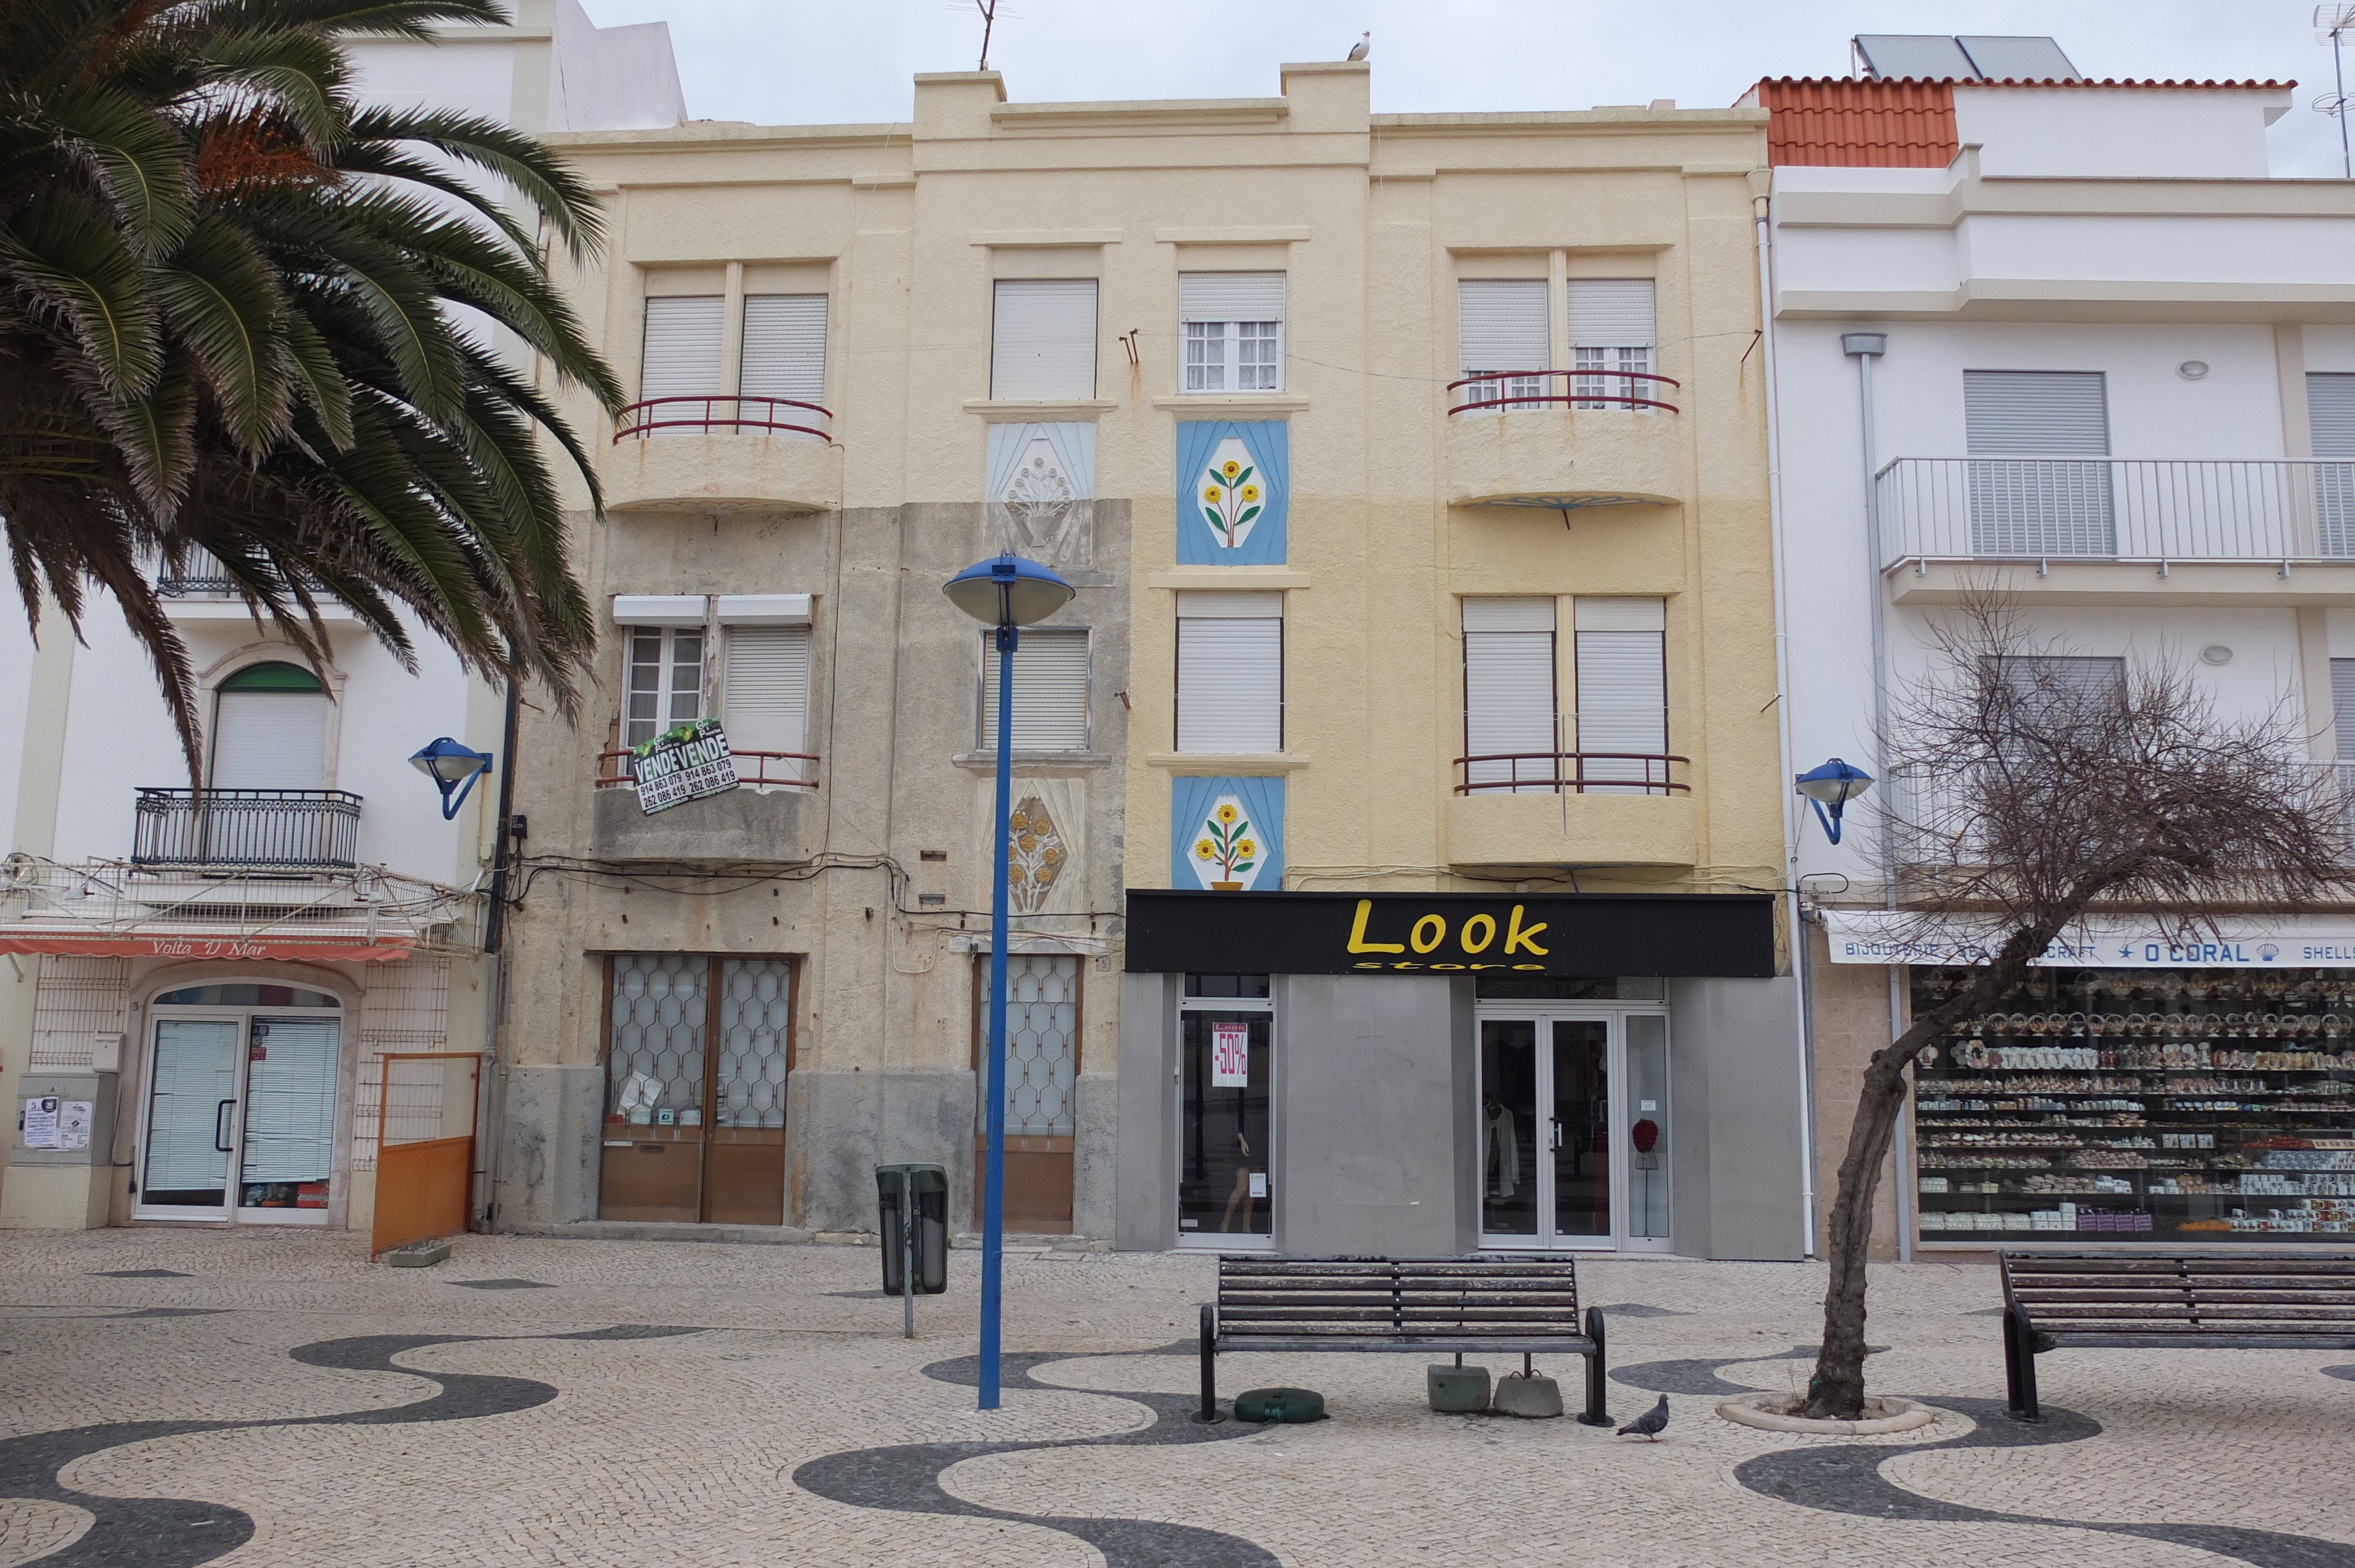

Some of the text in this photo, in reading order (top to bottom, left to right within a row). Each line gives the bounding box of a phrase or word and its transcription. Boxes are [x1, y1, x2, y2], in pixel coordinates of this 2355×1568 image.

[675, 733, 730, 769] VENDE
[635, 749, 680, 783] VENDE
[685, 759, 731, 780] 914 863 079
[641, 773, 682, 796] 914 863 079
[689, 780, 704, 793] 262
[705, 775, 719, 788] 086
[721, 770, 735, 782] 419
[644, 795, 657, 808] 262
[658, 790, 671, 803] 086
[672, 785, 686, 797] 419
[1346, 899, 1549, 955] Look
[153, 941, 192, 954] Volta
[227, 942, 266, 955] Mar
[2145, 944, 2250, 962] O CORAL
[1102, 959, 1106, 968] 5
[1352, 962, 1546, 970] store
[133, 1002, 138, 1011] 3
[1215, 1033, 1246, 1075] -50%
[1213, 1077, 1246, 1085] SALDOS
